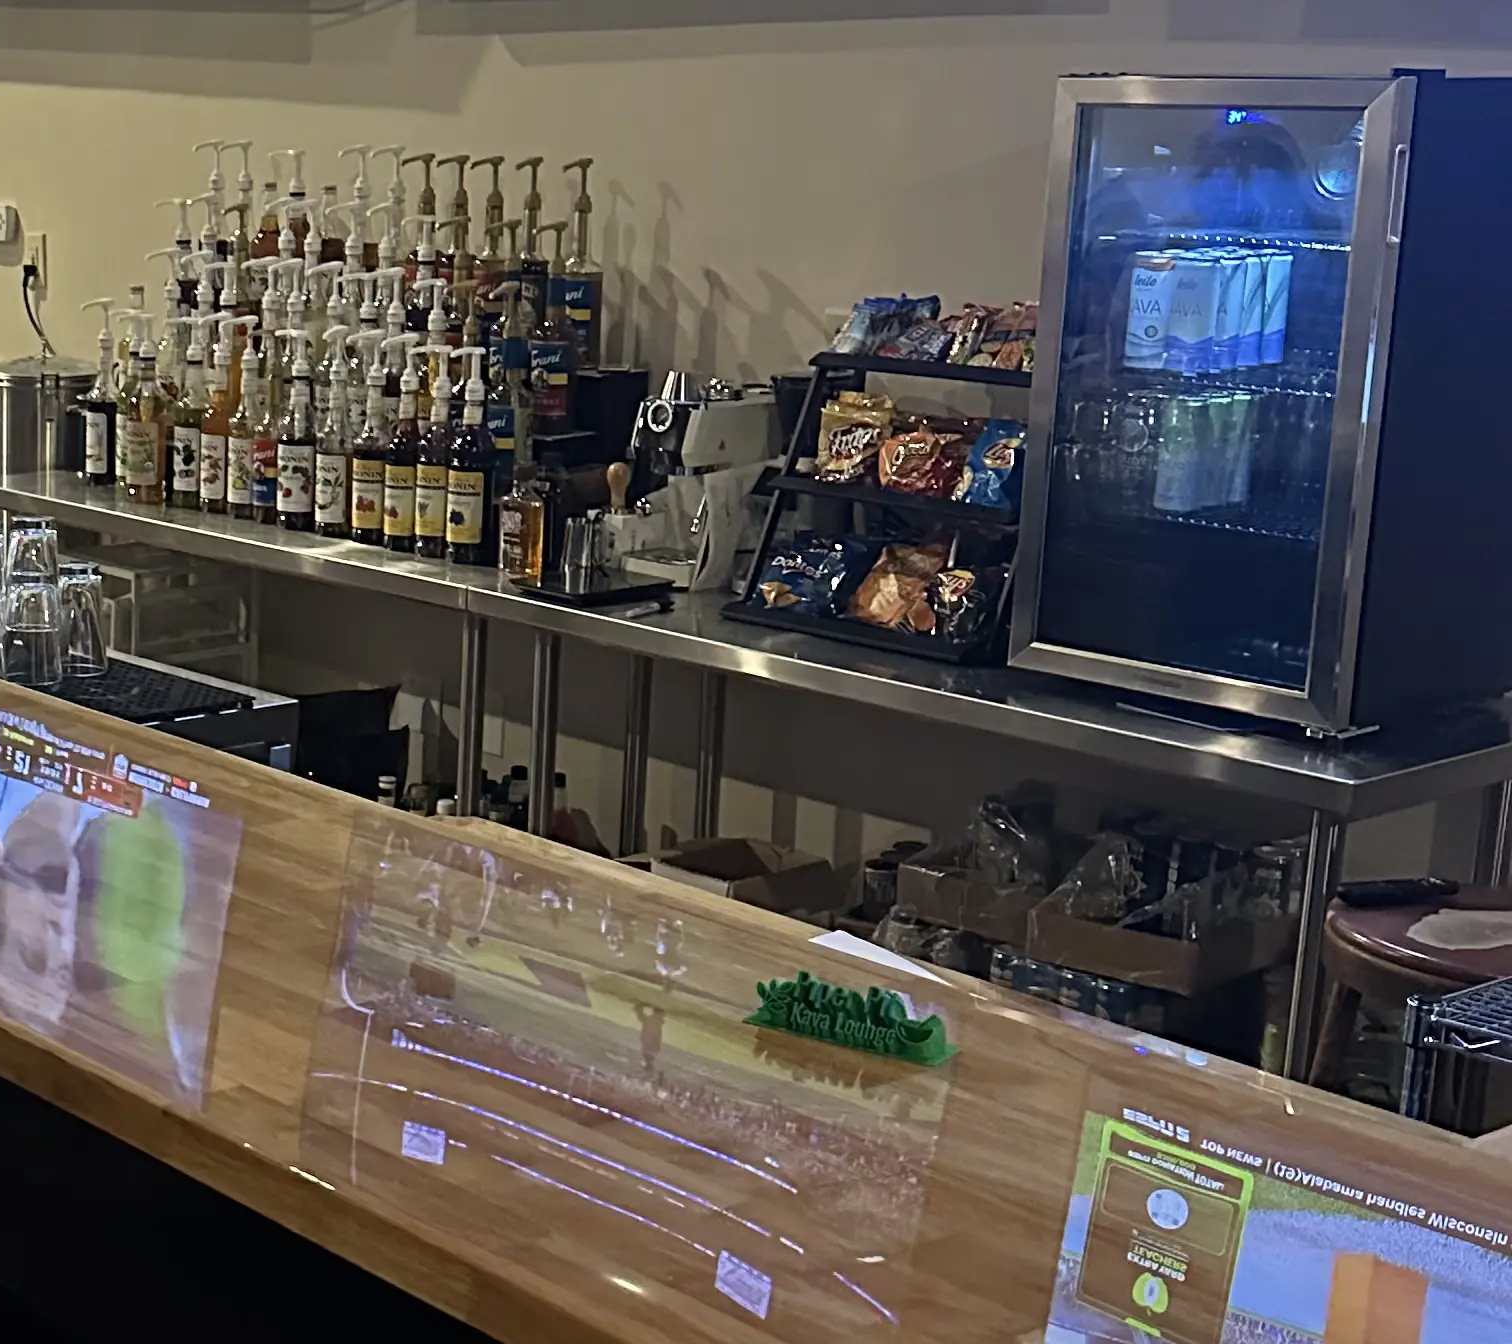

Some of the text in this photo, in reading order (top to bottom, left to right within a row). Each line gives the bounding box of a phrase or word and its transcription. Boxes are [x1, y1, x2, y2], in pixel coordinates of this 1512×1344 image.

[565, 286, 585, 301] ani
[1130, 299, 1162, 316] AVA
[1171, 302, 1204, 317] AVA
[487, 414, 508, 429] ani
[829, 425, 882, 453] Fritos
[771, 555, 822, 579] Doritos
[790, 1001, 898, 1047] Kava Lounge
